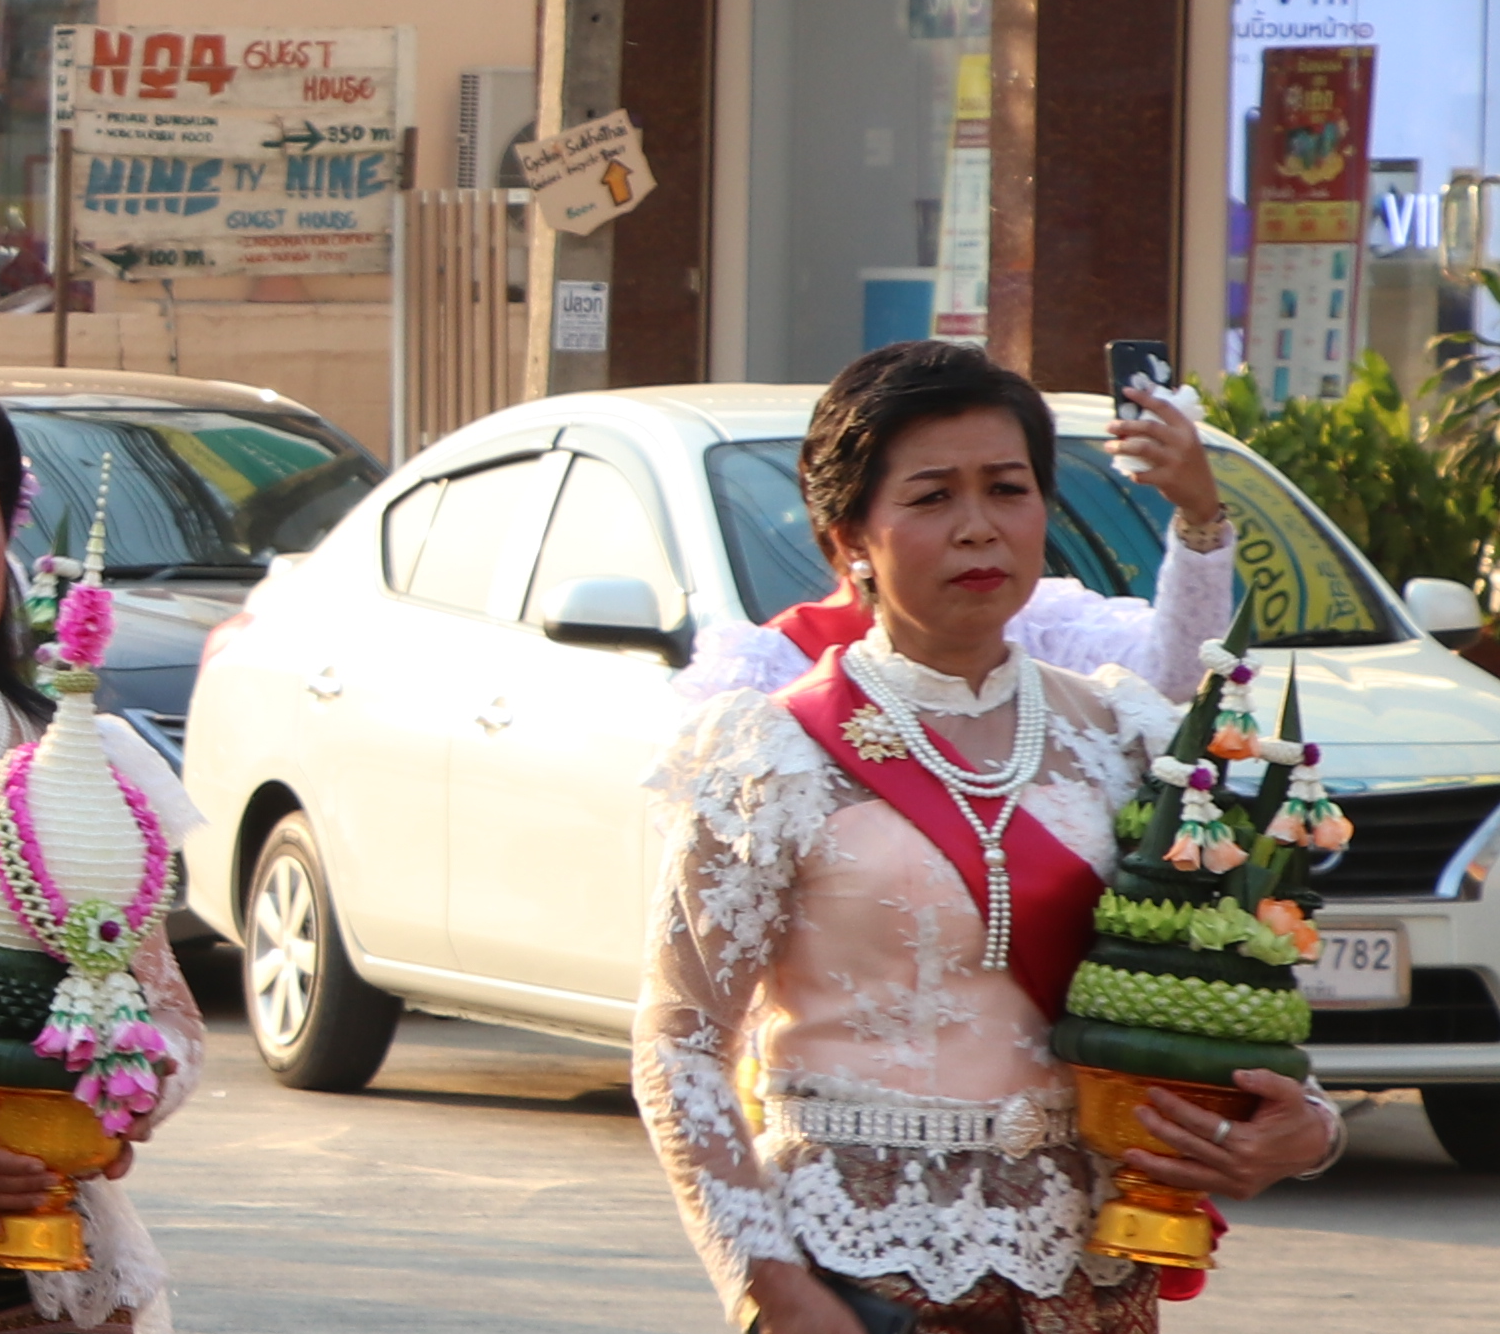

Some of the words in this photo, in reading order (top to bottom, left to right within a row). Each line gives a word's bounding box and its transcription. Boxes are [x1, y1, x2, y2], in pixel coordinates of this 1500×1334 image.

[243, 40, 337, 70] GUEST
[303, 75, 376, 104] HOUSE
[327, 125, 364, 143] 350
[84, 156, 224, 216] NINE
[233, 163, 267, 191] TY
[286, 152, 387, 199] NINE
[226, 207, 288, 229] GUEST
[297, 210, 358, 229] HOUSE
[562, 290, 604, 314] ปลวก
